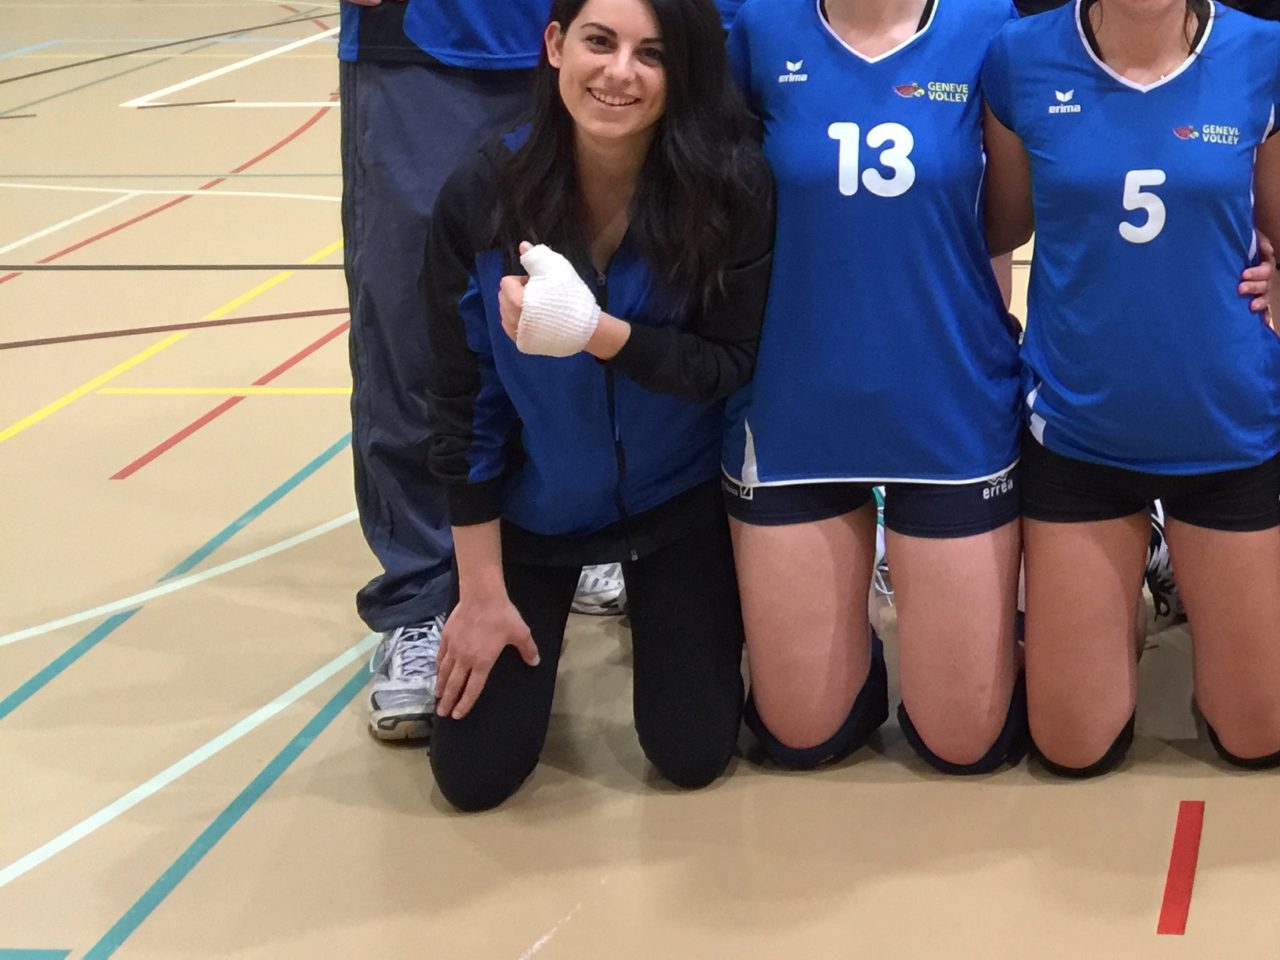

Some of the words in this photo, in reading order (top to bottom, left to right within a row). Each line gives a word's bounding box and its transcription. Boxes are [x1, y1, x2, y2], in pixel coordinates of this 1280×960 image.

[779, 73, 808, 82] erima
[928, 81, 969, 94] GENEVE
[928, 91, 969, 103] VOLLEY
[1049, 104, 1082, 115] erima
[1202, 133, 1240, 145] VOLLEY
[827, 122, 916, 198] 13
[1119, 169, 1167, 244] 5
